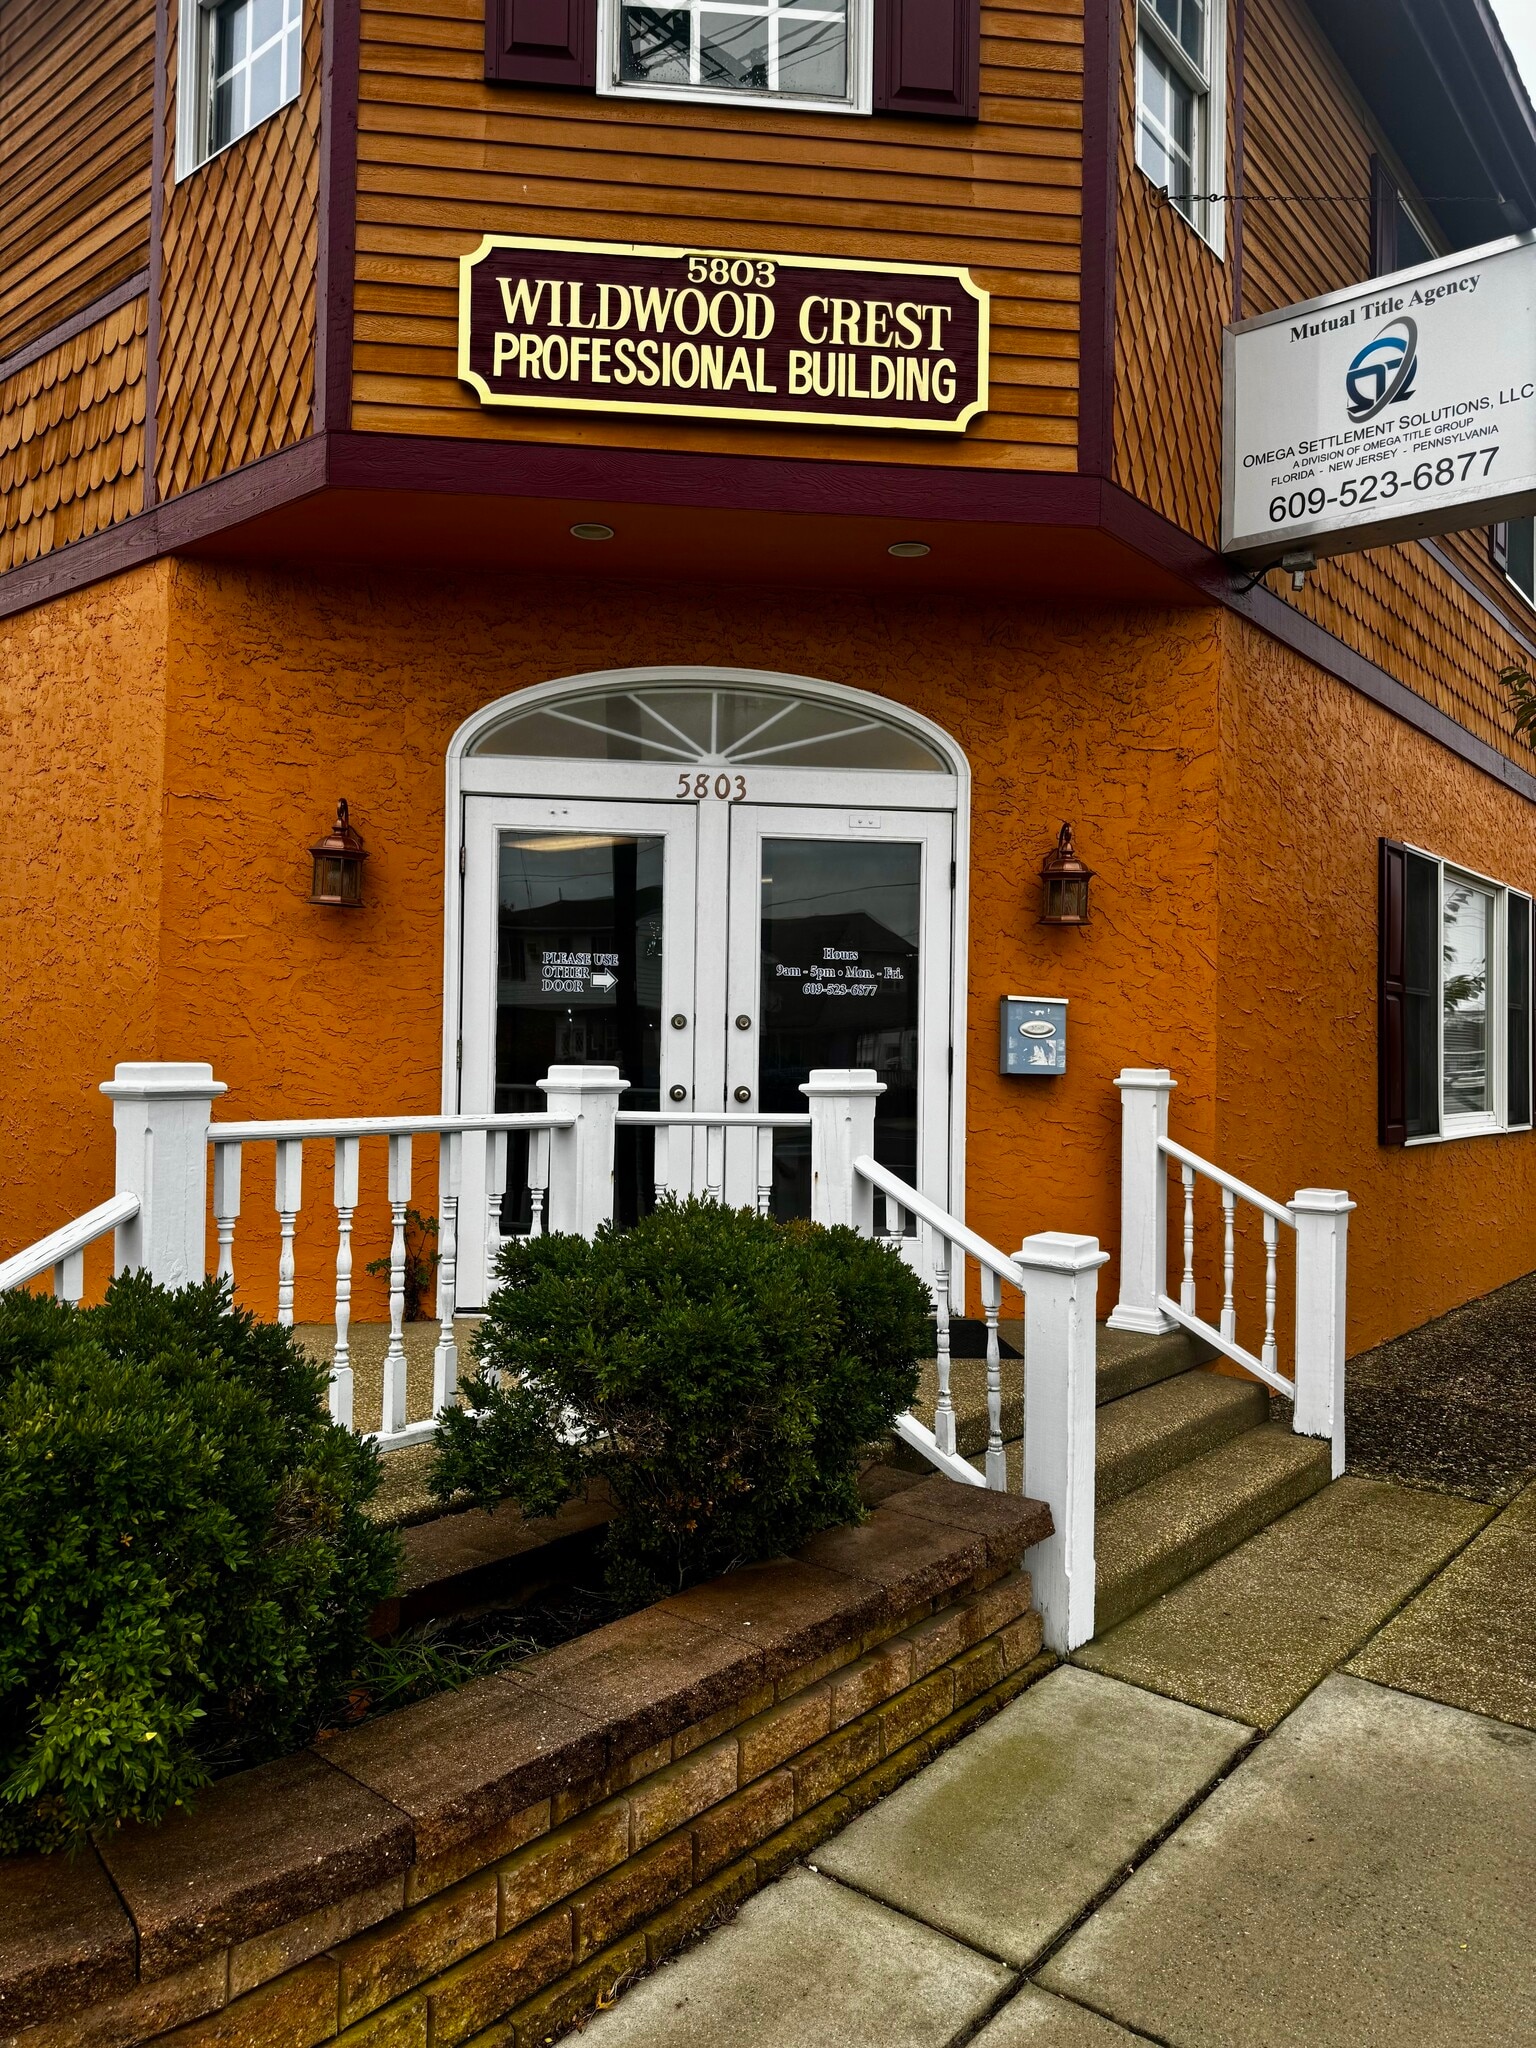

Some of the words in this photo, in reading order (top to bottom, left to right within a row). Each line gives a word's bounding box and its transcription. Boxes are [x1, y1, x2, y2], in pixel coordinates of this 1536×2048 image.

[688, 257, 775, 288] 5803
[495, 277, 775, 340] WILDWOOD
[799, 296, 951, 350] CREST
[1290, 310, 1355, 343] Mutual
[1361, 297, 1403, 321] Title
[1408, 274, 1480, 307] Agency
[493, 332, 777, 393] PROFESSIONAL
[788, 349, 956, 403] BUILDING
[1243, 446, 1295, 468] OMEGA
[1299, 420, 1393, 456] SETTLEMENT
[1399, 397, 1494, 430] SOLUTIONS,
[1500, 384, 1534, 404] LLC
[1272, 469, 1314, 486] FLORIDA
[1329, 458, 1353, 473] NEW
[1356, 448, 1397, 466] JERSEY
[1413, 425, 1499, 453] PENNSYLVANIA
[1302, 451, 1344, 467] DIVISION
[1347, 445, 1360, 455] OF
[1363, 436, 1401, 452] OMEGA
[1403, 428, 1431, 442] TITLE
[1434, 417, 1474, 435] GROUP
[1269, 446, 1500, 522] 609-523-6877
[676, 773, 746, 801] 5803
[542, 952, 591, 965] PLEASE
[593, 953, 619, 966] USE
[823, 948, 858, 960] Hours
[542, 966, 590, 978] OTHER
[542, 979, 584, 992] DOOR
[776, 964, 801, 976] 9am
[810, 966, 835, 980] 5pm
[845, 966, 874, 978] Mon.
[884, 967, 903, 979] Fri.
[803, 983, 878, 996] 609-523-6877
